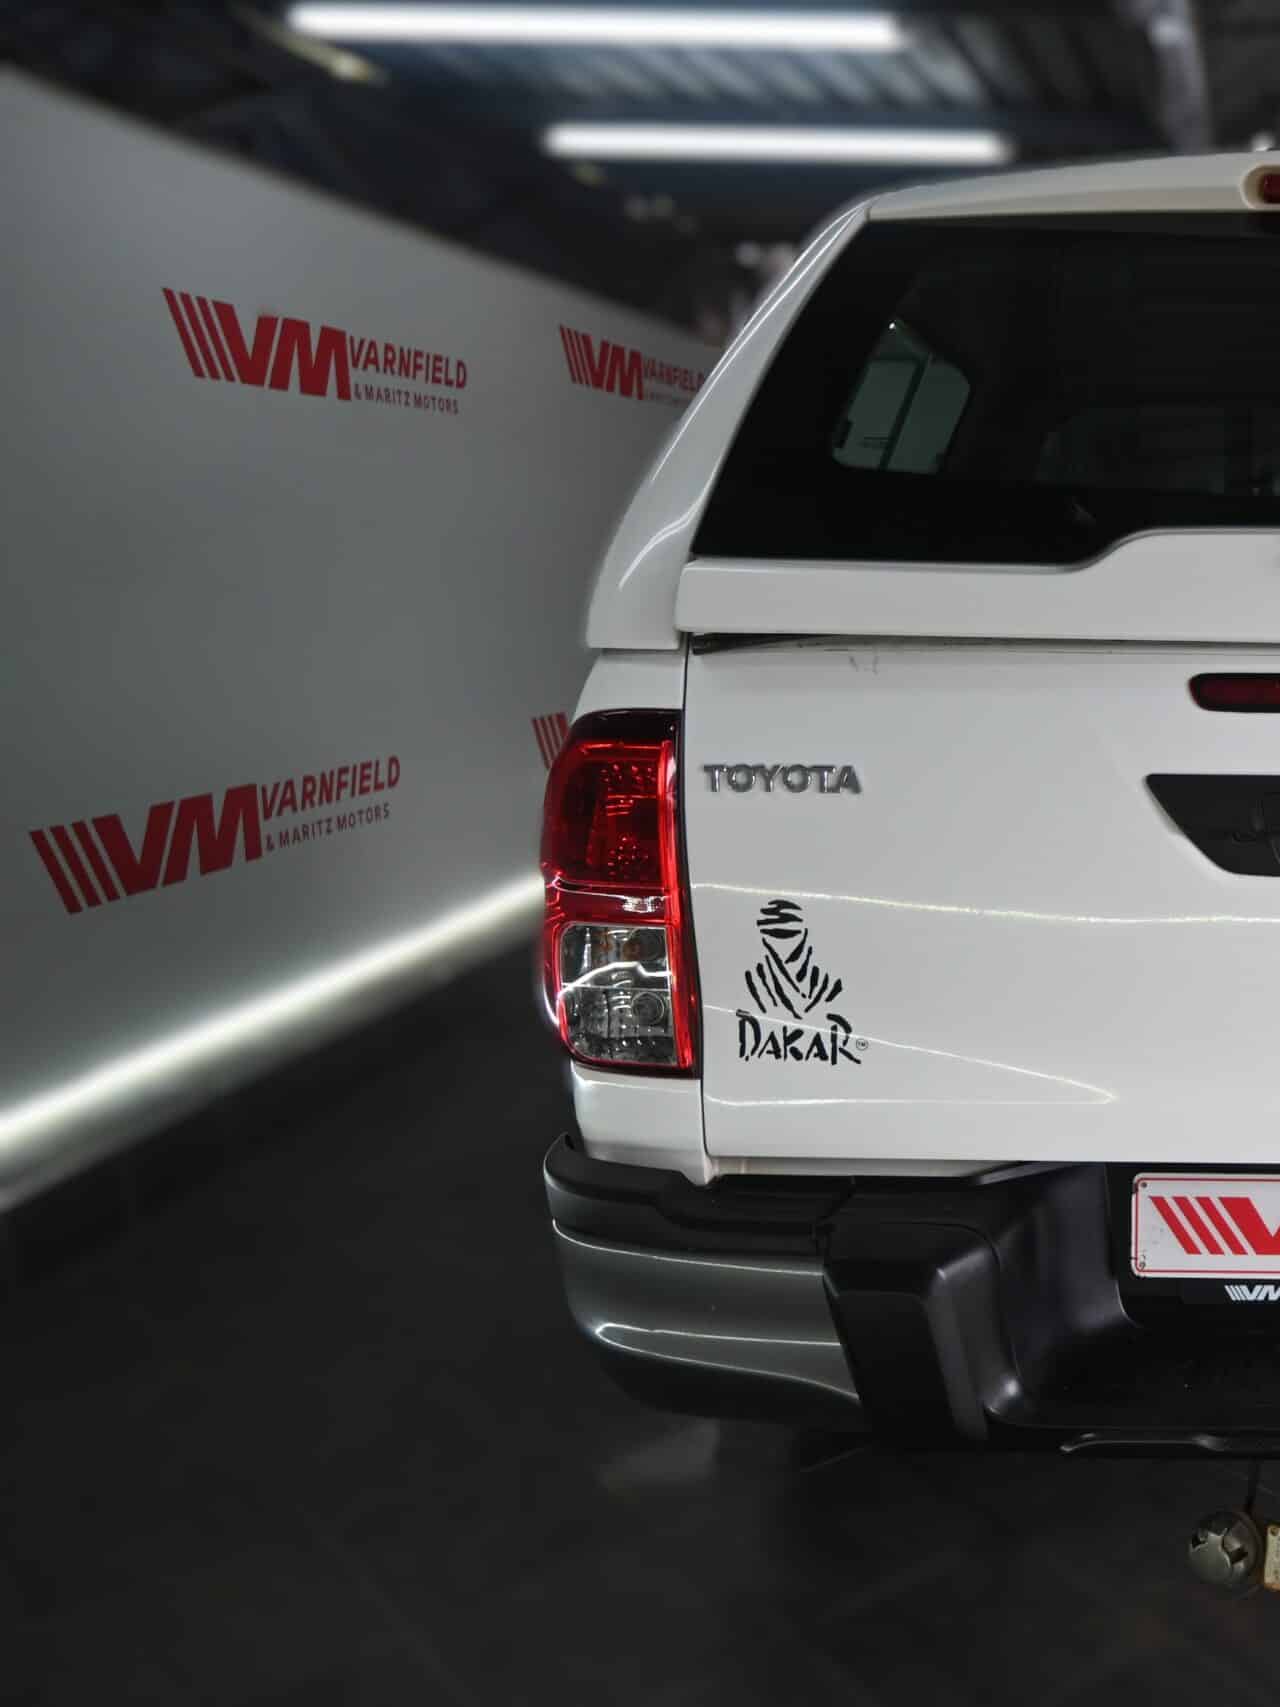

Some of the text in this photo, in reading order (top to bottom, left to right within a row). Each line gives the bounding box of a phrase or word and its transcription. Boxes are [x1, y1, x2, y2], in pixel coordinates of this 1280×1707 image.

[349, 335, 467, 390] VARNFIELD
[364, 384, 410, 407] MARITZ
[414, 392, 459, 415] MOTORS
[261, 755, 401, 820] VARNFIELD
[702, 764, 862, 794] TOYOTA
[279, 818, 333, 848] MARITZ
[336, 803, 390, 832] MOTORS
[736, 1009, 861, 1065] DAKAR
